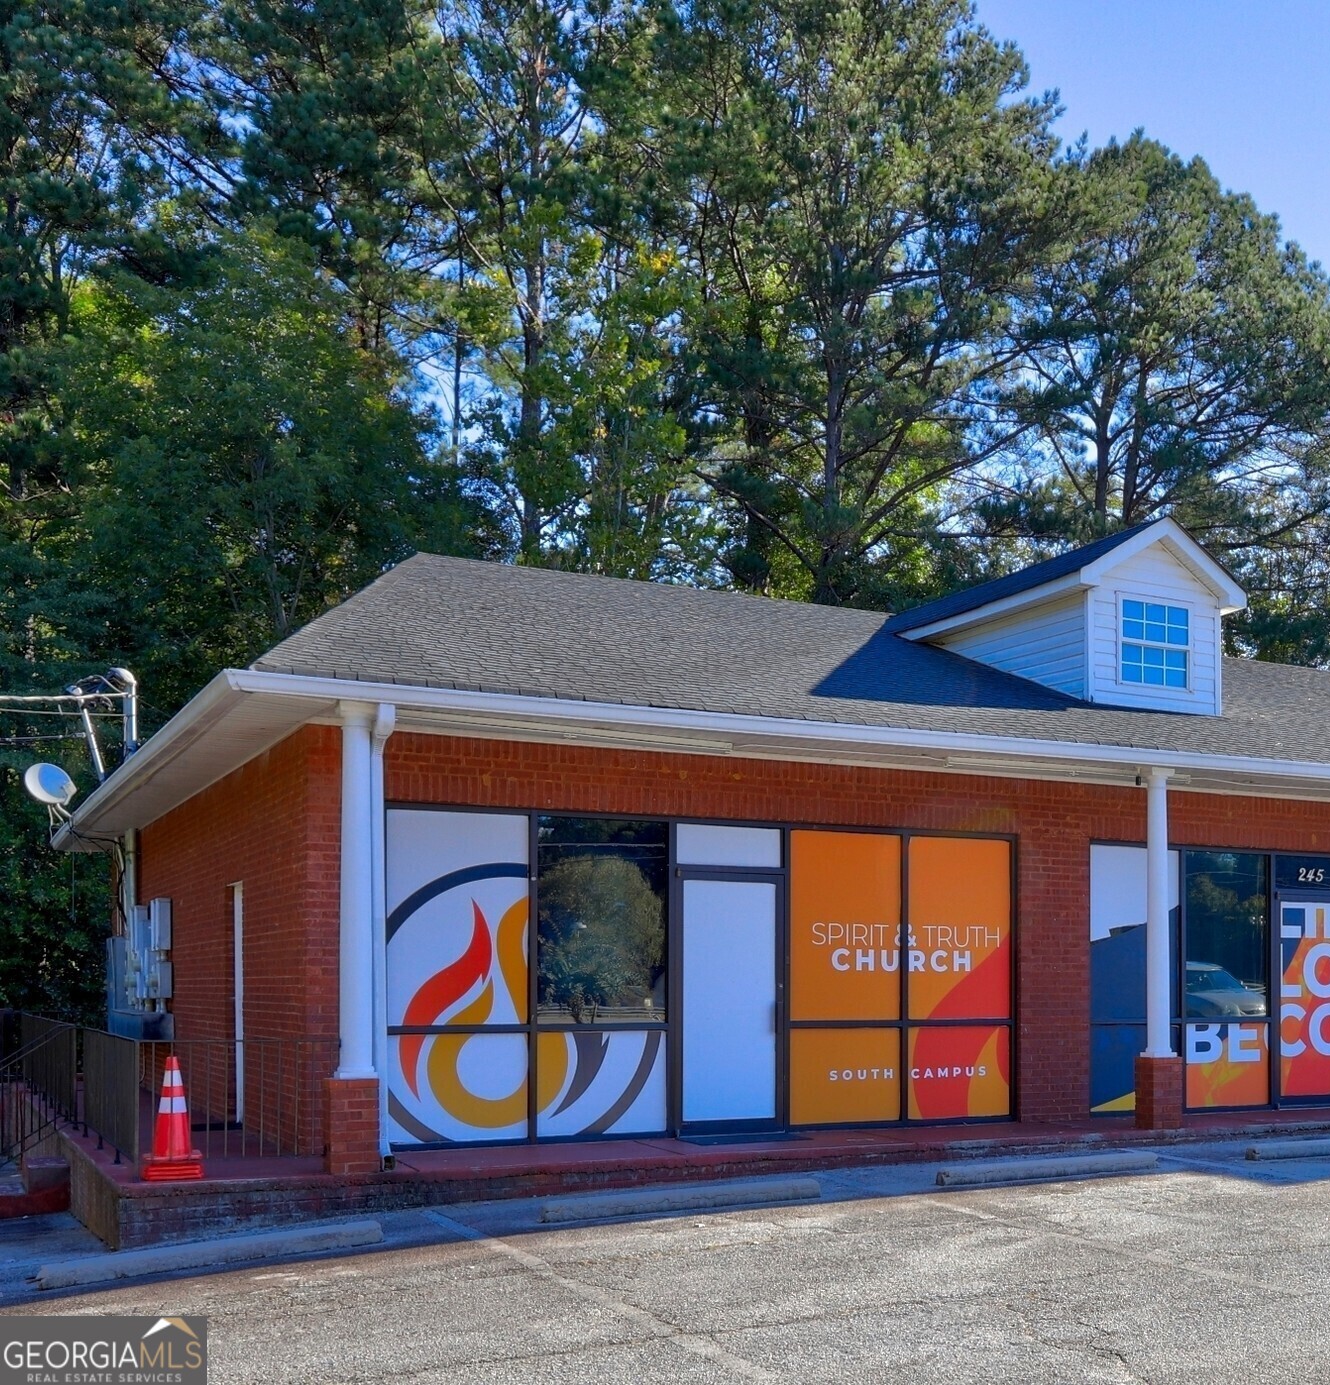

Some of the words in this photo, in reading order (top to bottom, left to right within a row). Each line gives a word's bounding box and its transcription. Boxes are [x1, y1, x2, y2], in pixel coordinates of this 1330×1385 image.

[1298, 867, 1325, 882] 245
[812, 922, 889, 946] SPIRIT
[894, 923, 917, 947] &
[922, 925, 1000, 948] TRUTH
[831, 948, 972, 972] CHURCH
[829, 1068, 894, 1081] SOUTH
[910, 1066, 987, 1079] CAMPUS
